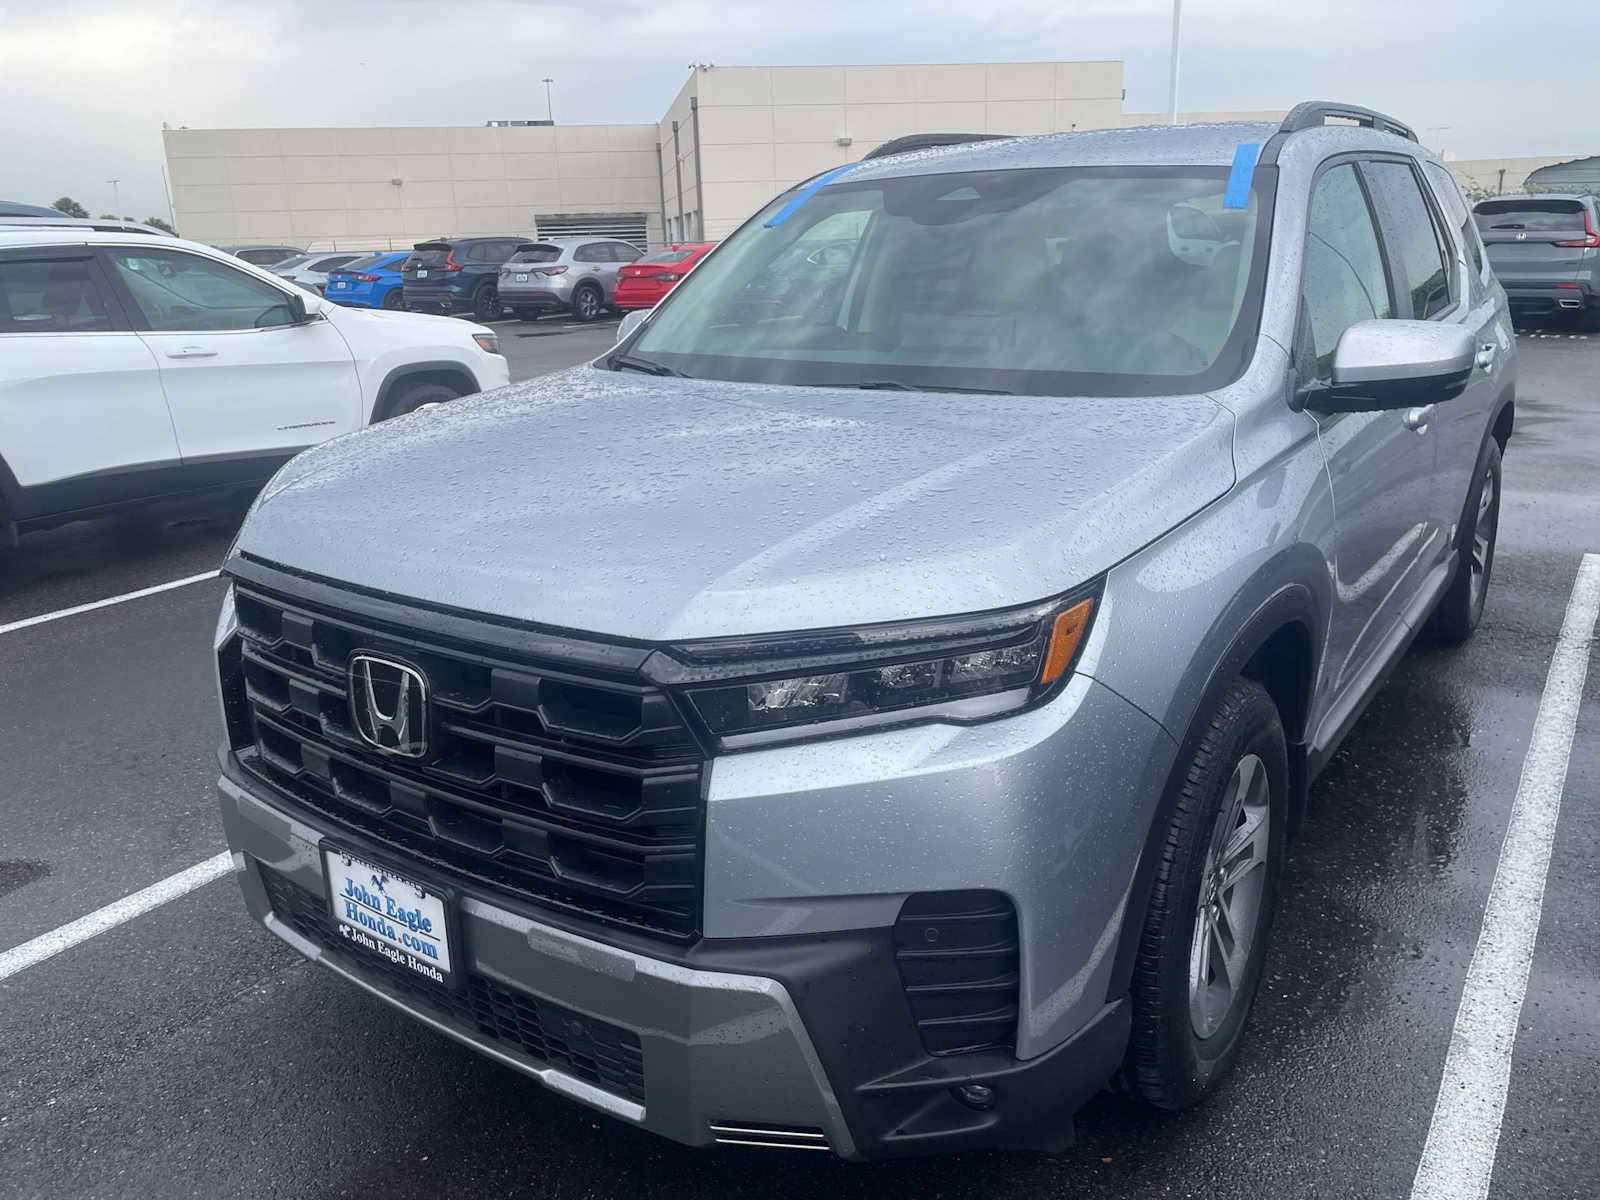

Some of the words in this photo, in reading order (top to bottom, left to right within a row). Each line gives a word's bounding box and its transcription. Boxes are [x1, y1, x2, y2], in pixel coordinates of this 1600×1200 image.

[344, 877, 382, 911] John
[386, 895, 432, 933] Eagle
[345, 902, 438, 960] Honda.com
[351, 927, 375, 950] John
[377, 941, 406, 964] Eagle
[408, 956, 443, 983] Honda
